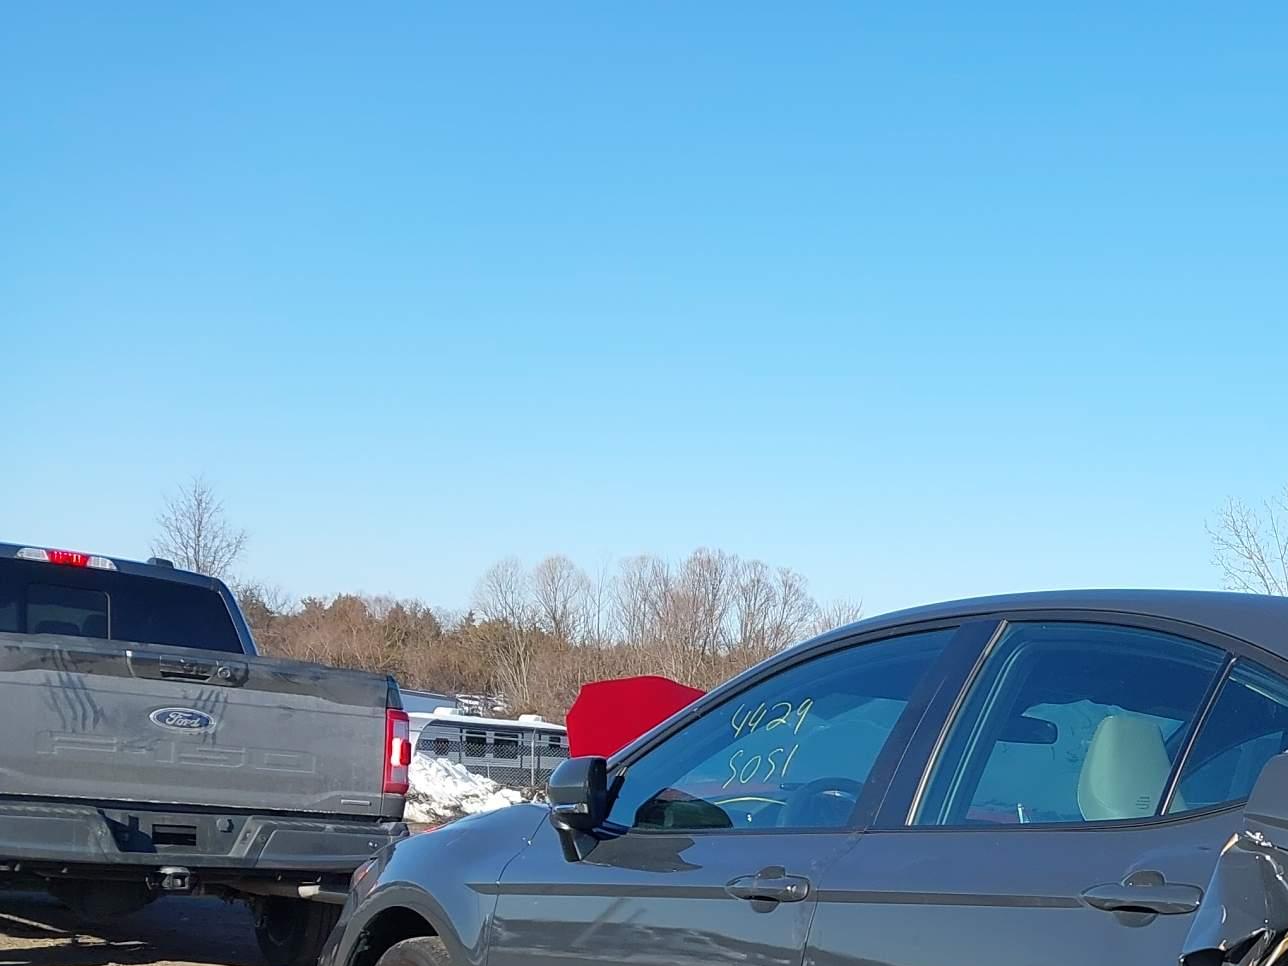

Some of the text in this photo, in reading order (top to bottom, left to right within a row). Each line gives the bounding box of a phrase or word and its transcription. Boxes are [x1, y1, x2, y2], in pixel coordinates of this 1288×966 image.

[165, 711, 201, 728] Ford
[731, 698, 814, 738] 4429
[721, 744, 799, 790] 5051
